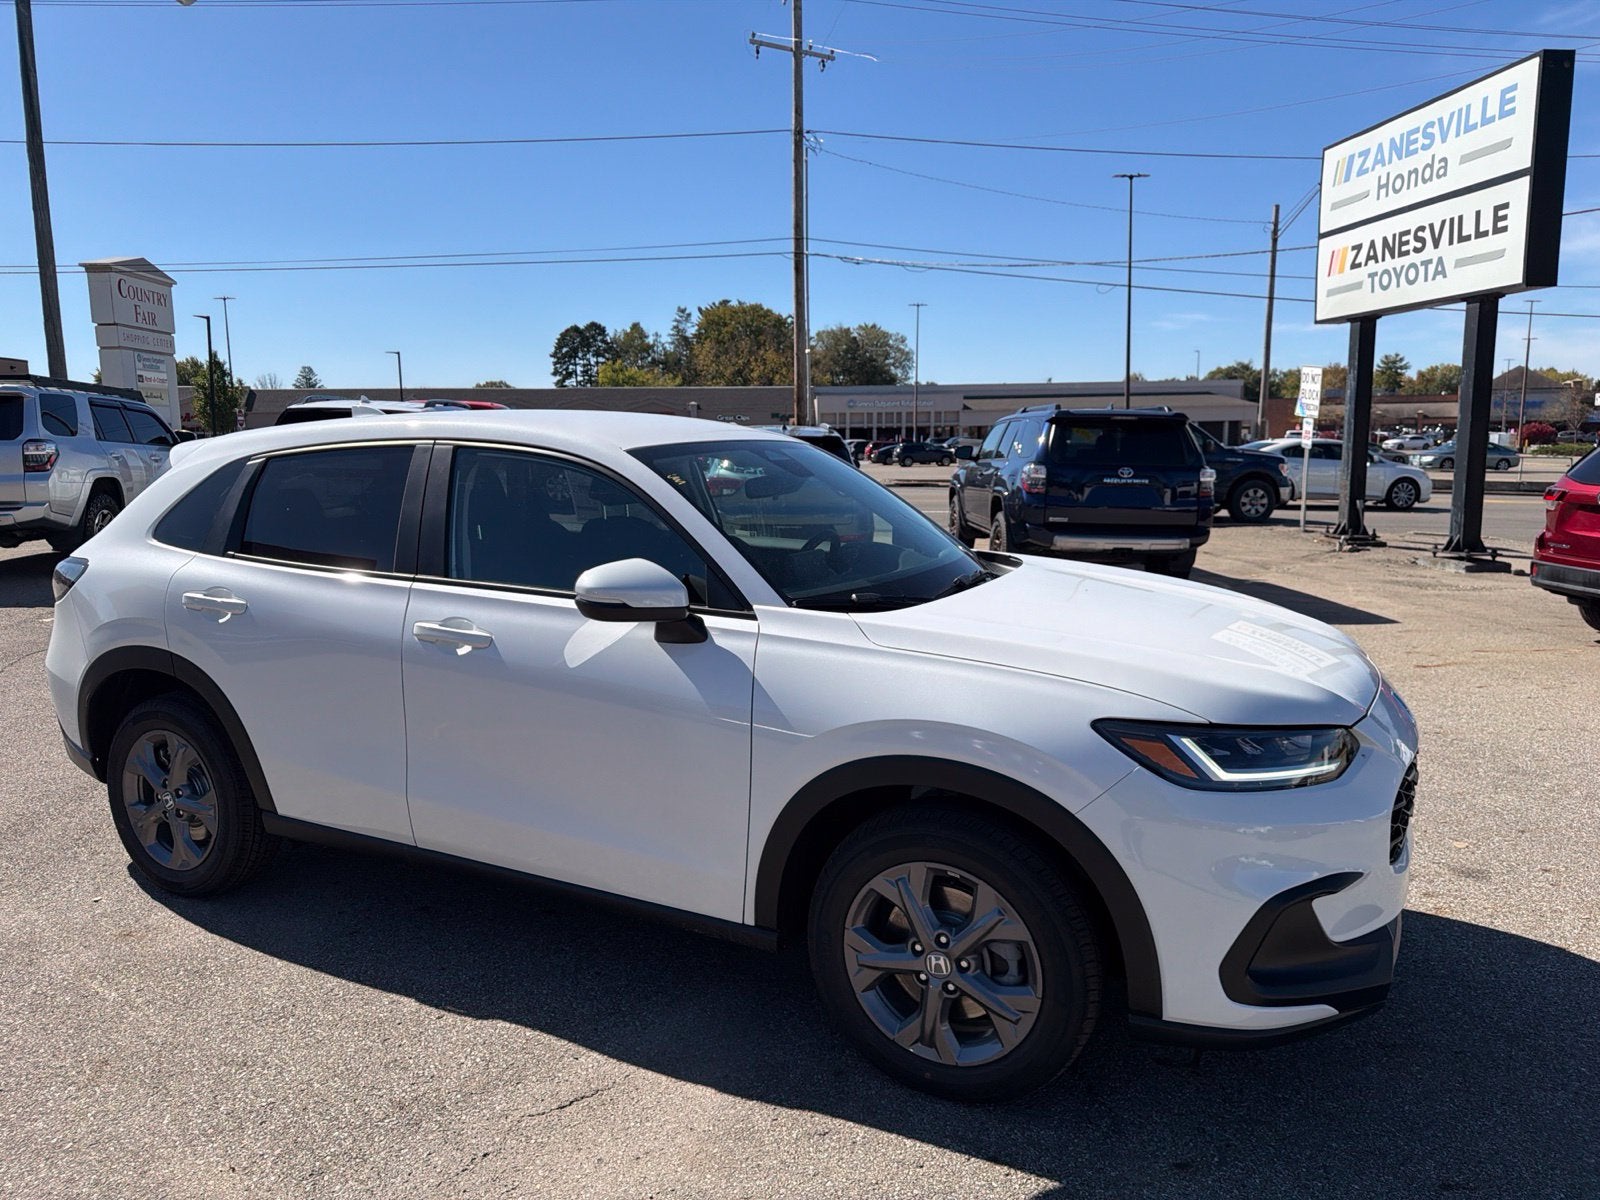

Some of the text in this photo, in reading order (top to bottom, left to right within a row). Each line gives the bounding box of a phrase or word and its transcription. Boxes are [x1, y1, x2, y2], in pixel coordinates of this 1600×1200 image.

[1355, 82, 1519, 178] ZANESVILLE
[1376, 153, 1449, 201] Honda
[1349, 201, 1510, 270] ZANESVILLE
[117, 278, 168, 308] COUNTRY
[1367, 256, 1447, 293] TOYOTA
[134, 304, 158, 327] FAIR
[152, 337, 173, 349] CENTER
